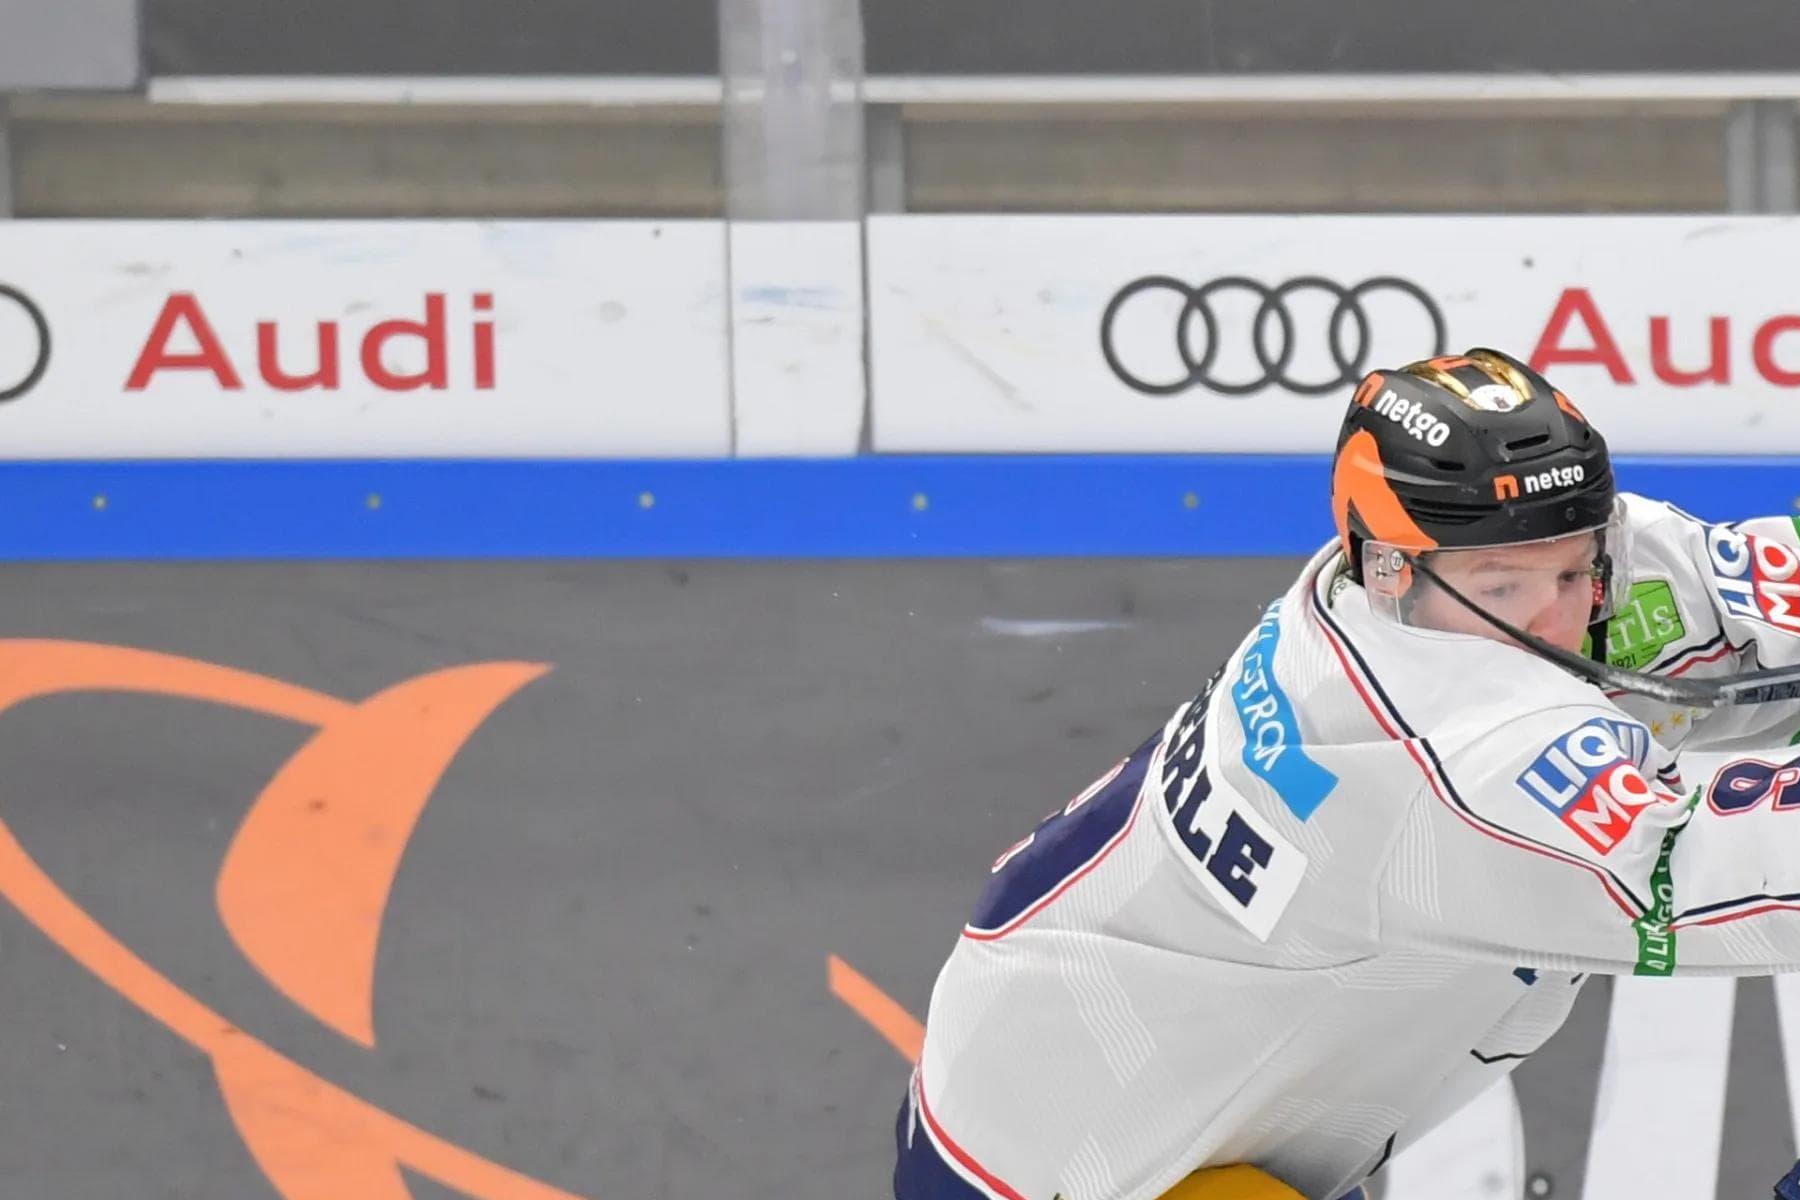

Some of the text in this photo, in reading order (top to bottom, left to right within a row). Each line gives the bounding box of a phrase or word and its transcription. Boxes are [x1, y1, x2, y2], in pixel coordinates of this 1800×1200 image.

[124, 291, 497, 391] Audi
[1374, 388, 1450, 447] netgo
[1524, 464, 1584, 494] netgo
